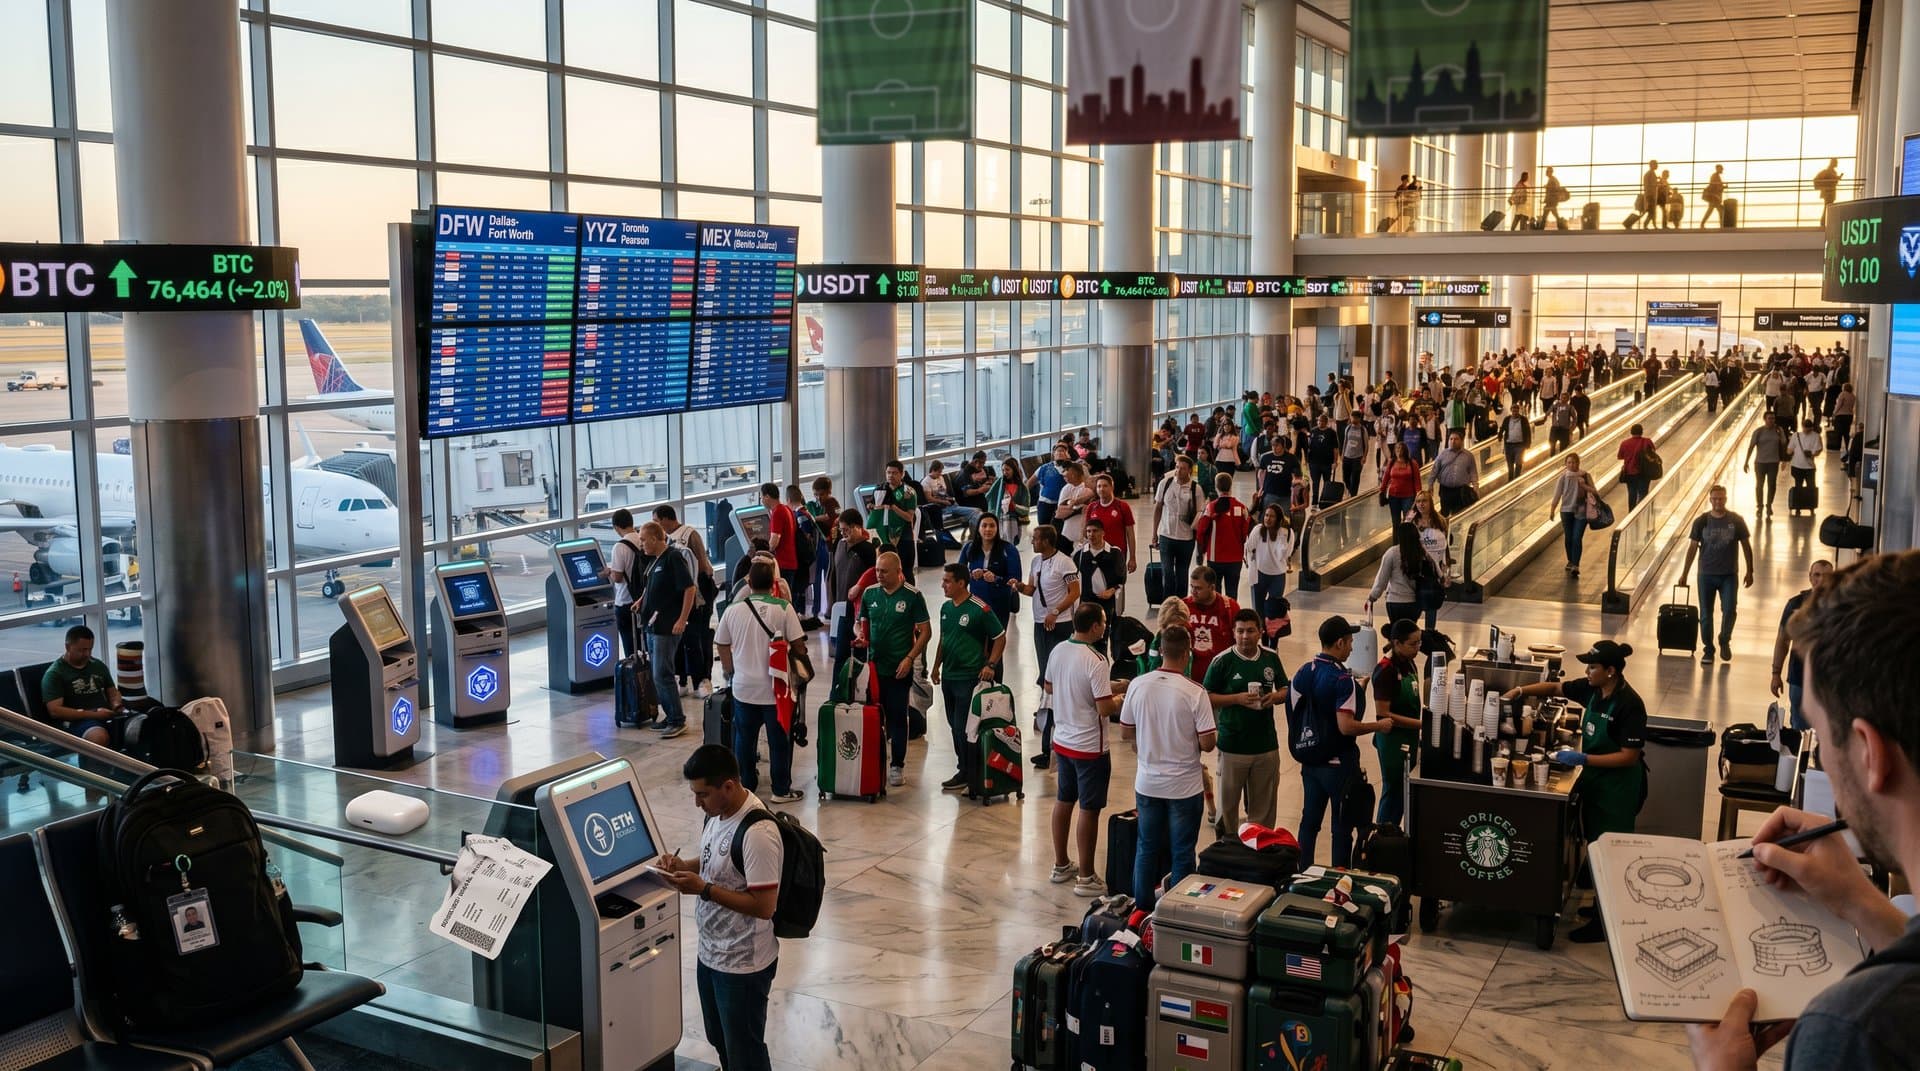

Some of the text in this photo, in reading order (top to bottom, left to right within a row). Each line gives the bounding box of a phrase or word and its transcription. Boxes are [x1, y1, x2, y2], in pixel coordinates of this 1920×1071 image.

[439, 213, 485, 237] DFW
[489, 214, 519, 226] Dallas-
[621, 222, 650, 233] Toronto
[488, 228, 534, 241] Fort Worth
[585, 221, 618, 243] YYZ
[702, 228, 732, 247] MEX
[1841, 218, 1882, 246] USDT
[621, 234, 650, 246] Pearson
[213, 254, 254, 274] BTC
[896, 270, 920, 282] USDT
[1839, 256, 1880, 288] $1.00
[11, 262, 95, 298] BTC
[807, 274, 870, 295] USDT
[1029, 279, 1053, 295] USDT
[1076, 279, 1099, 294] BTC
[1137, 276, 1156, 286] BTC
[1180, 281, 1198, 294] USDT
[1255, 281, 1281, 294] BTC
[147, 280, 223, 303] 76,464
[896, 285, 919, 298] $1.00
[1307, 282, 1330, 294] SDT
[1454, 284, 1480, 294] USDT
[610, 811, 635, 832] ETH
[1459, 860, 1514, 881] COFFEE
